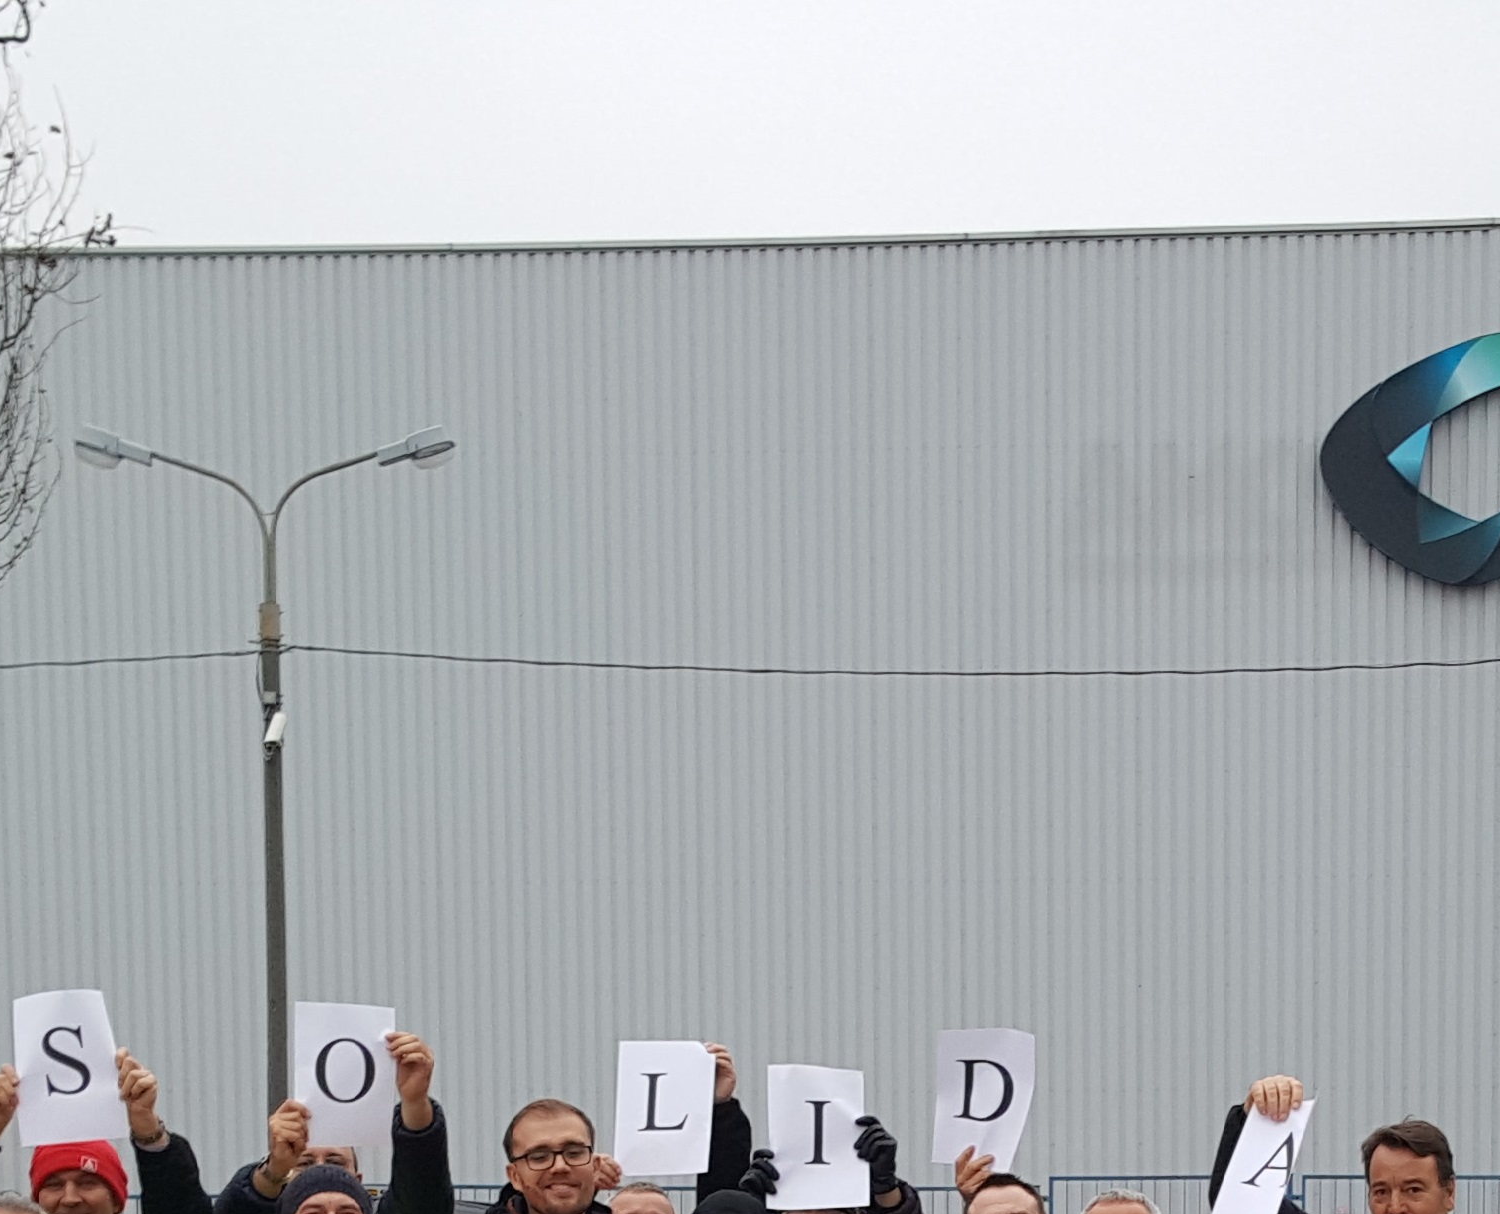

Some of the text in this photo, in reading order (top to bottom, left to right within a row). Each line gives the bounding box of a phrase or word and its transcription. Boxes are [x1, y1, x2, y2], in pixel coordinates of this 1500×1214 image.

[41, 1025, 92, 1097] S
[314, 1037, 375, 1103] O
[637, 1072, 688, 1132] L
[804, 1100, 832, 1166] I
[953, 1059, 1014, 1122] D
[1240, 1131, 1296, 1188] A
